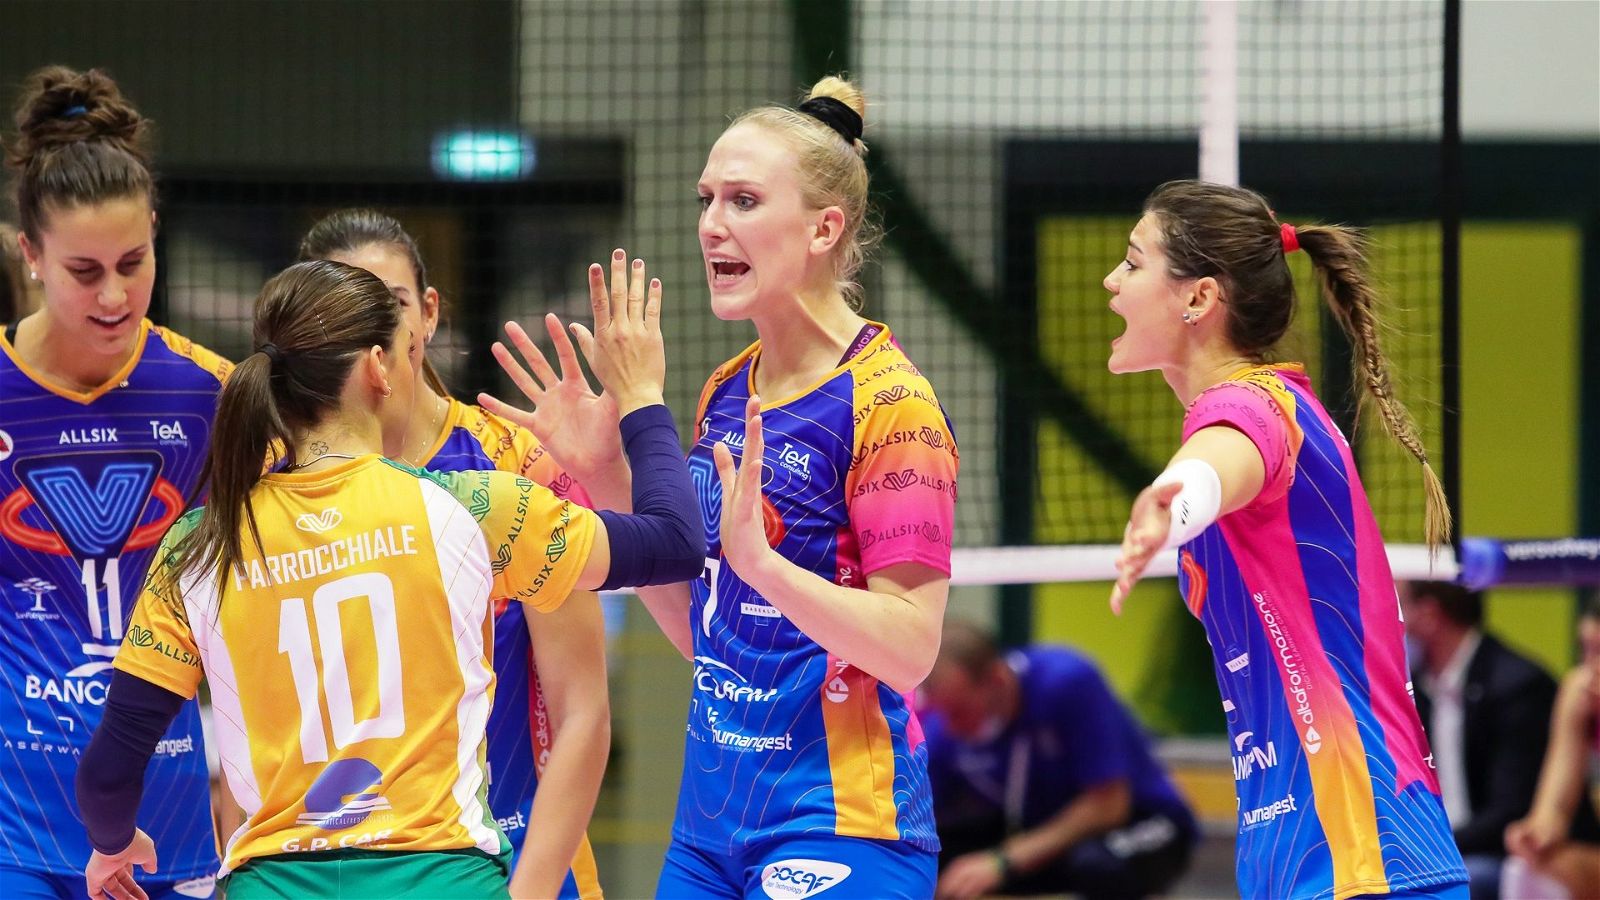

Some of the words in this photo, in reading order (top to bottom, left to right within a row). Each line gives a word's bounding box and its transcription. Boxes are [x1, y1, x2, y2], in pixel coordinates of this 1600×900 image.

[59, 428, 118, 444] ALLSIX
[507, 494, 530, 543] ALLSIX
[878, 524, 920, 543] ALLSIX
[233, 525, 418, 592] PARROCCHIALE
[81, 558, 122, 640] 11
[153, 641, 201, 668] ALLSIX
[278, 572, 405, 764] 10
[1253, 592, 1315, 725] altaformazione
[4, 740, 80, 756] ASERWA
[155, 734, 193, 757] angest
[282, 838, 332, 852] G.P.
